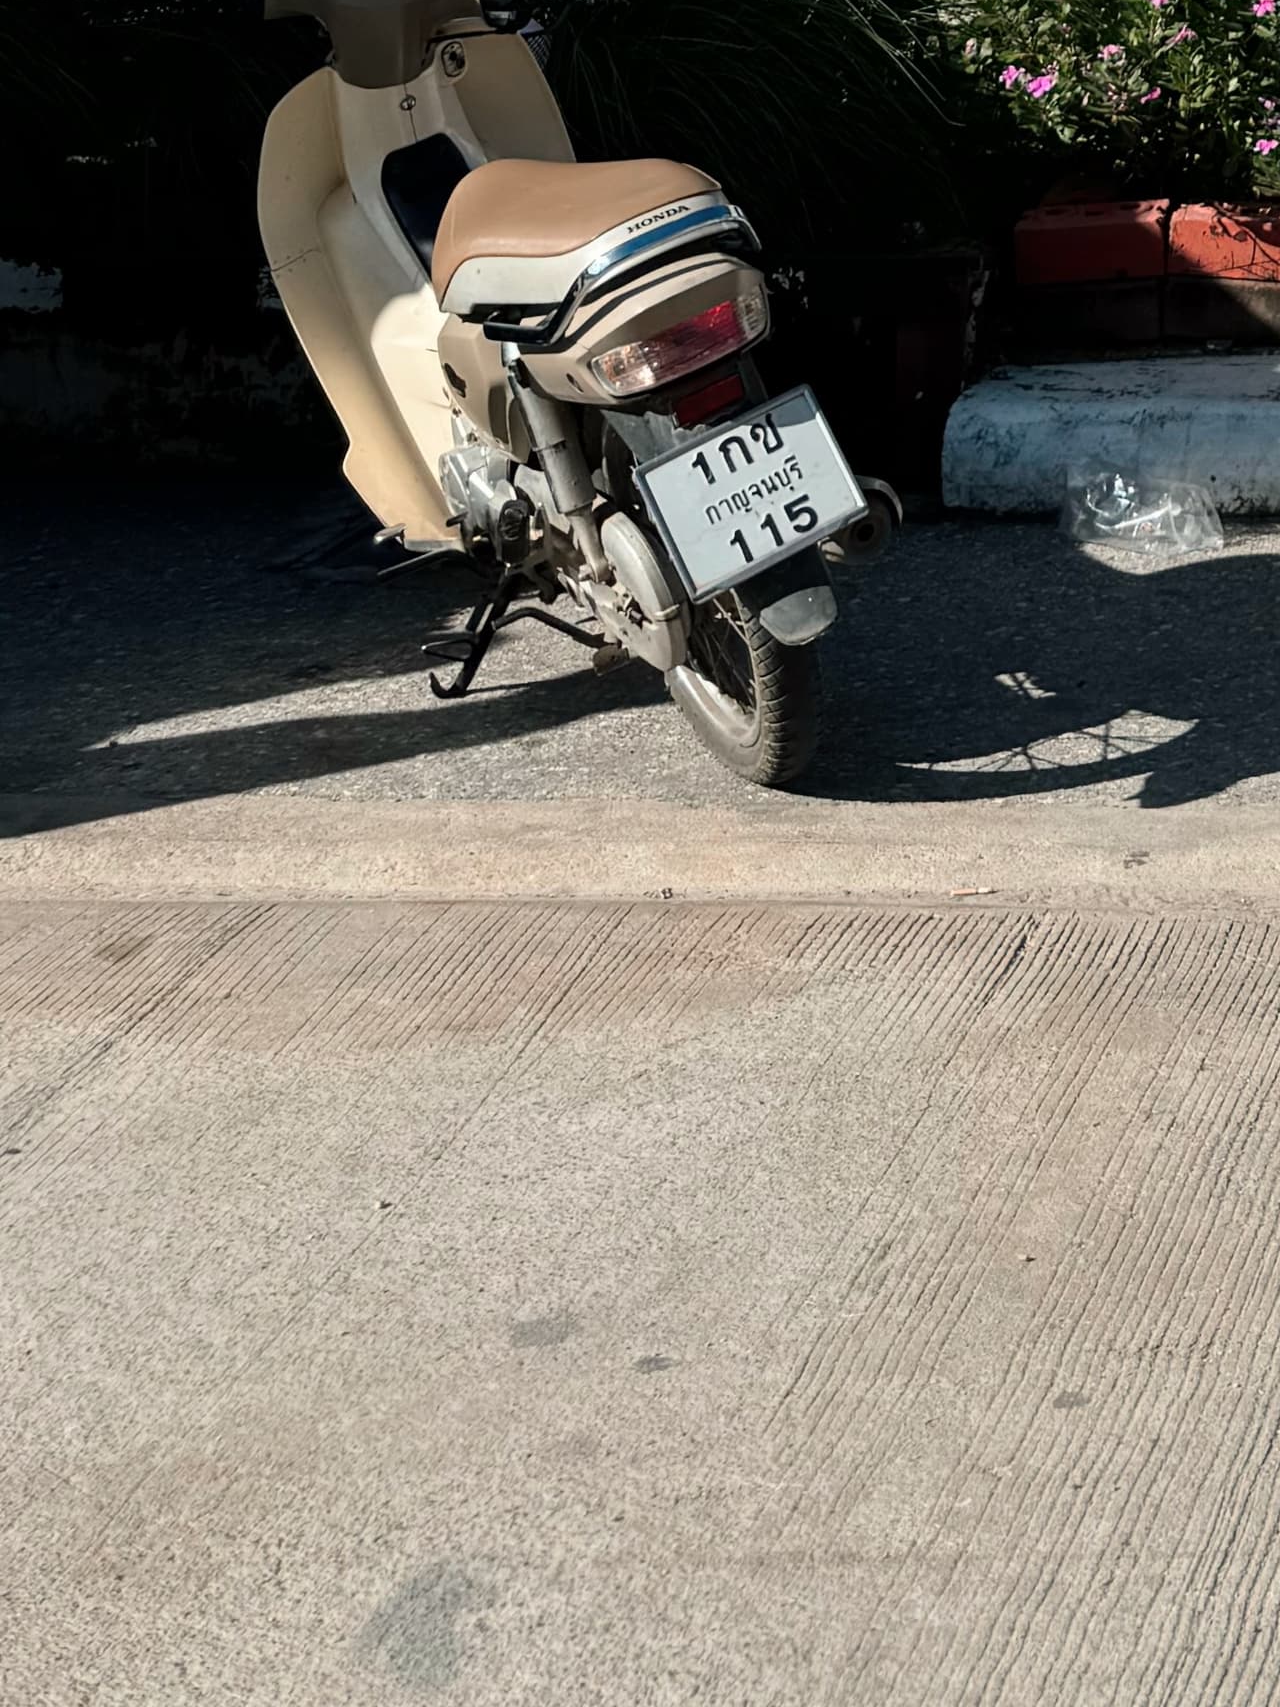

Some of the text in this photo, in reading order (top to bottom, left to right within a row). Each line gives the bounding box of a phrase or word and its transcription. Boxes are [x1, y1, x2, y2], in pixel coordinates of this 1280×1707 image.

[626, 204, 691, 234] HONDA
[705, 455, 803, 525] กาญจนบุรี
[730, 494, 818, 564] 115
